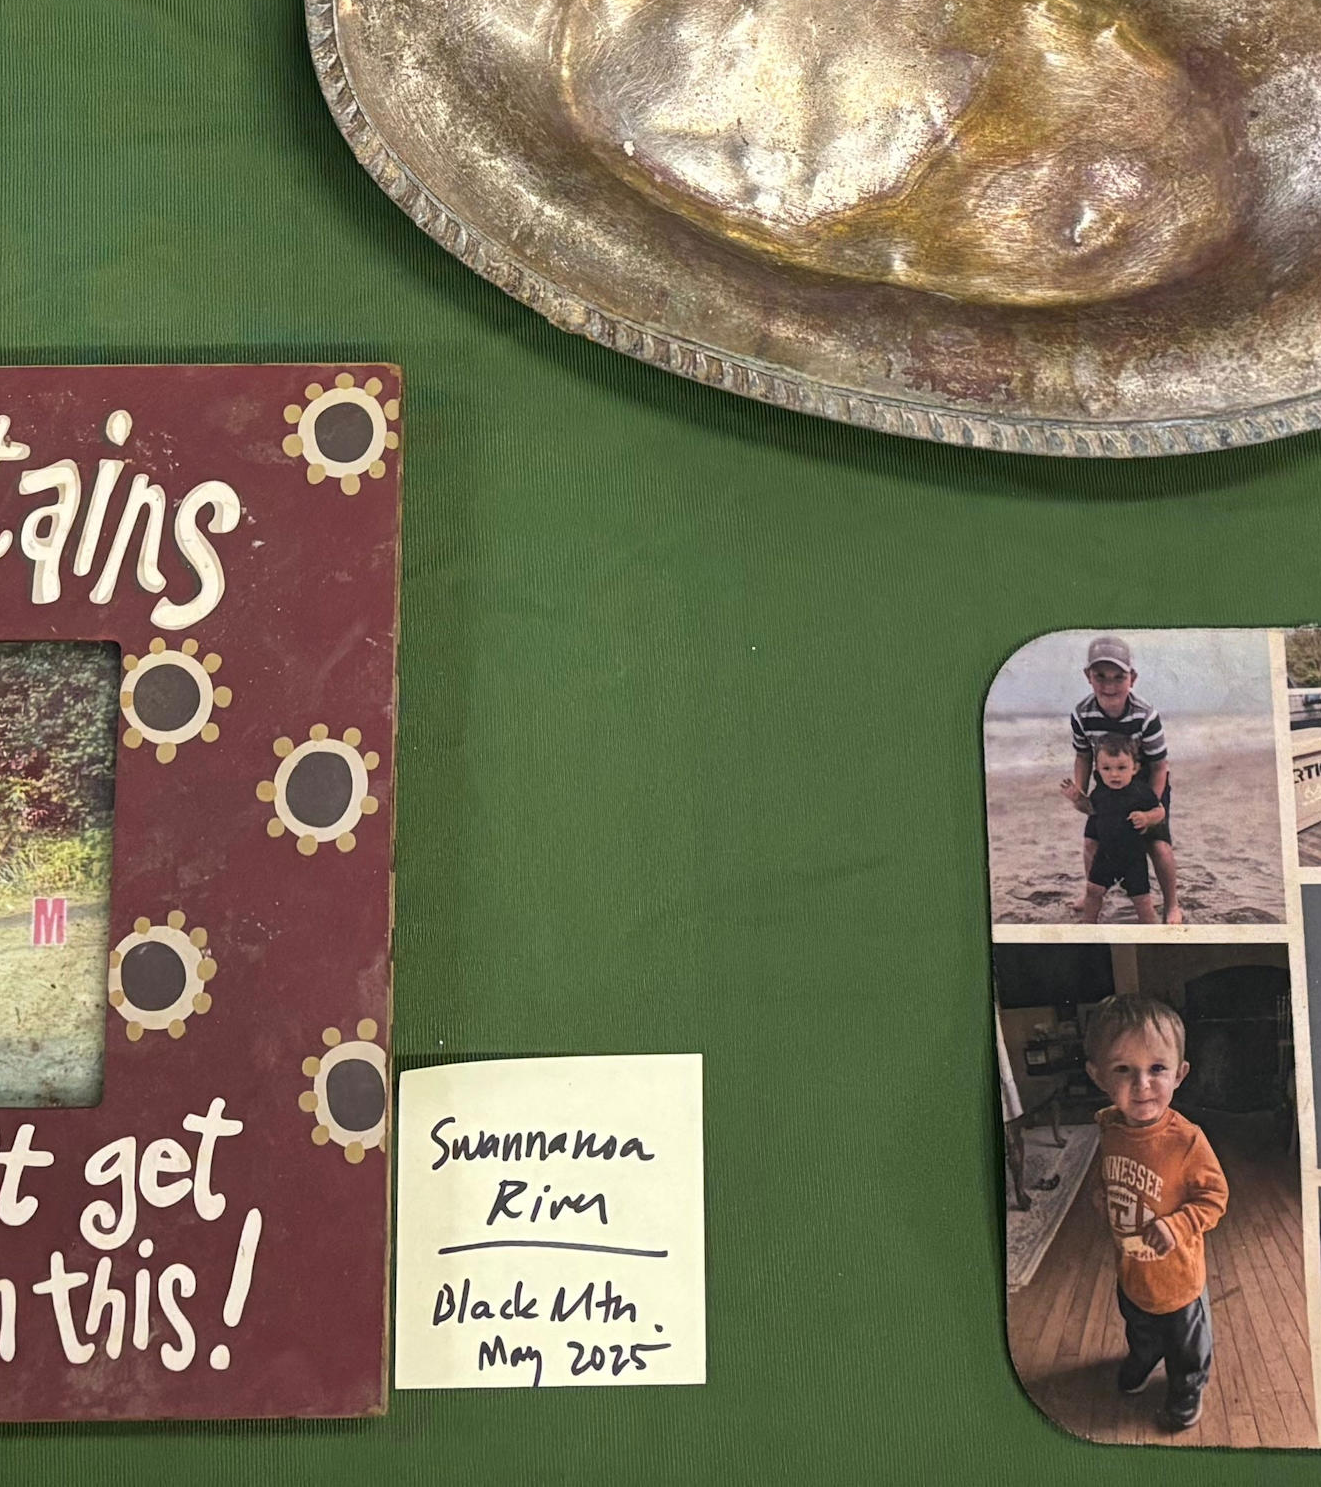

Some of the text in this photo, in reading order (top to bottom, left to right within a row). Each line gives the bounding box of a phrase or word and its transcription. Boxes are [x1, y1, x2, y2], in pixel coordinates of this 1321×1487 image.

[431, 1116, 655, 1170] Swannanoa
[79, 1096, 243, 1251] get
[486, 1179, 608, 1226] River
[31, 1208, 263, 1374] this!
[433, 1278, 539, 1326] Black
[479, 1335, 672, 1388] May 2025
